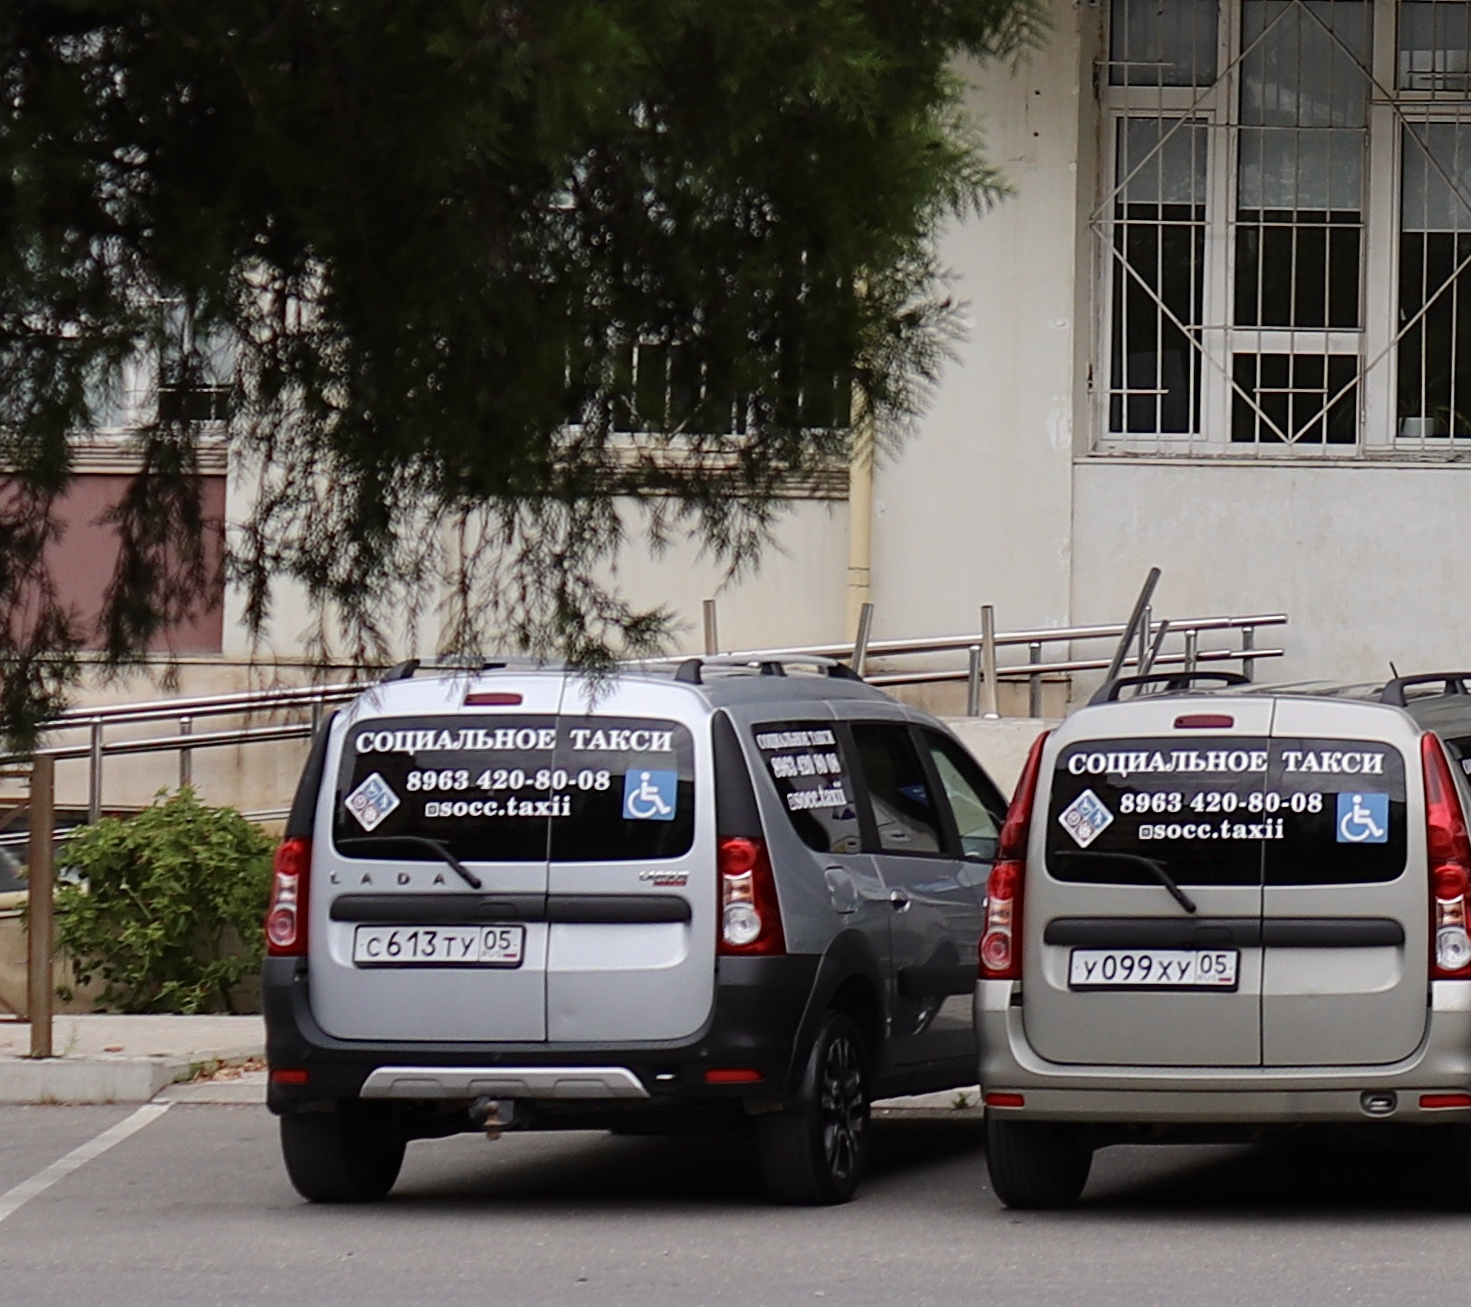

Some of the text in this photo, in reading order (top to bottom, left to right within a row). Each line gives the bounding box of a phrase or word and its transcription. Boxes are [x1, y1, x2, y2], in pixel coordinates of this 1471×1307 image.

[355, 728, 672, 756] СОЦИАЛЬНОЕ ТАКСИ
[1067, 749, 1385, 778] СОЦИАЛЬНОЕ ТАКСИ
[406, 769, 611, 792] 8963 420-80-08
[1119, 791, 1323, 814] 8963 420-80-08
[484, 929, 512, 951] 05
[1199, 954, 1228, 974] 05
